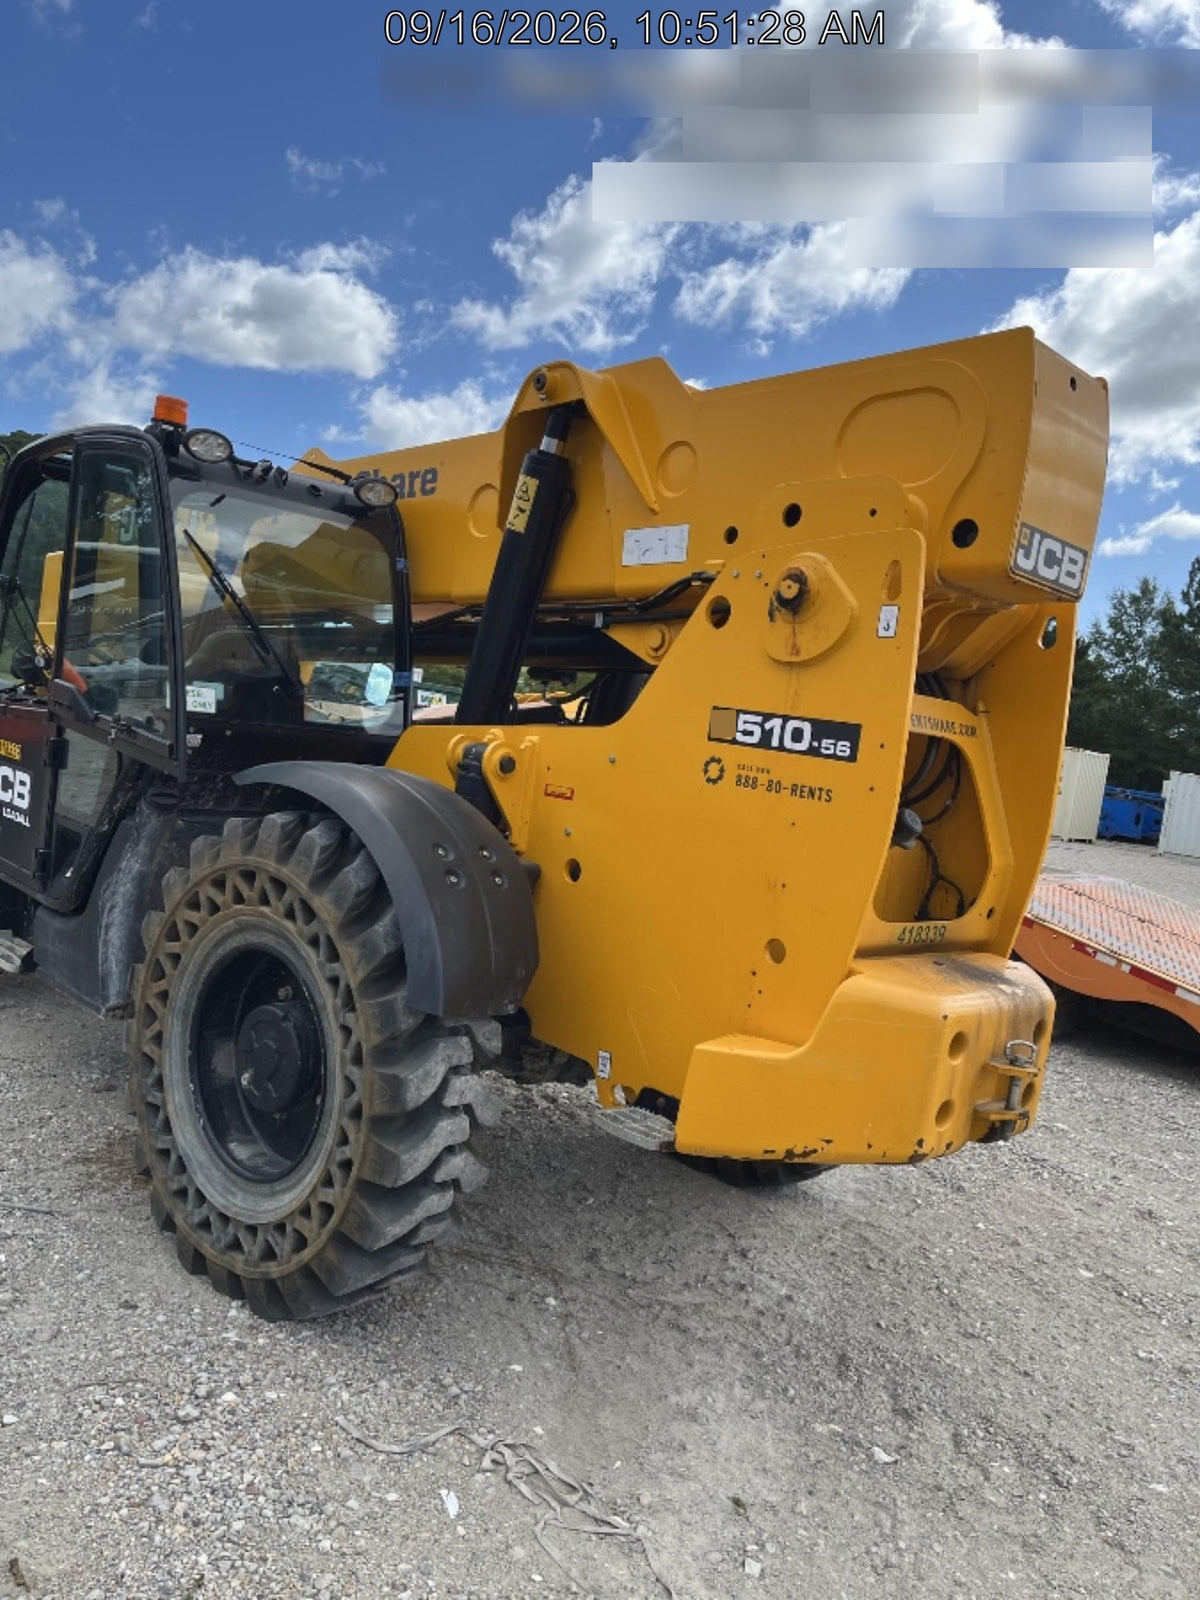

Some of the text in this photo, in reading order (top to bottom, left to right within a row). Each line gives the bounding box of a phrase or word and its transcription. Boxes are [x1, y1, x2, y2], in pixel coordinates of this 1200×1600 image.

[1016, 532, 1084, 590] JCB
[735, 774, 833, 803] 888-80-RENTS
[897, 924, 947, 945] 418339
